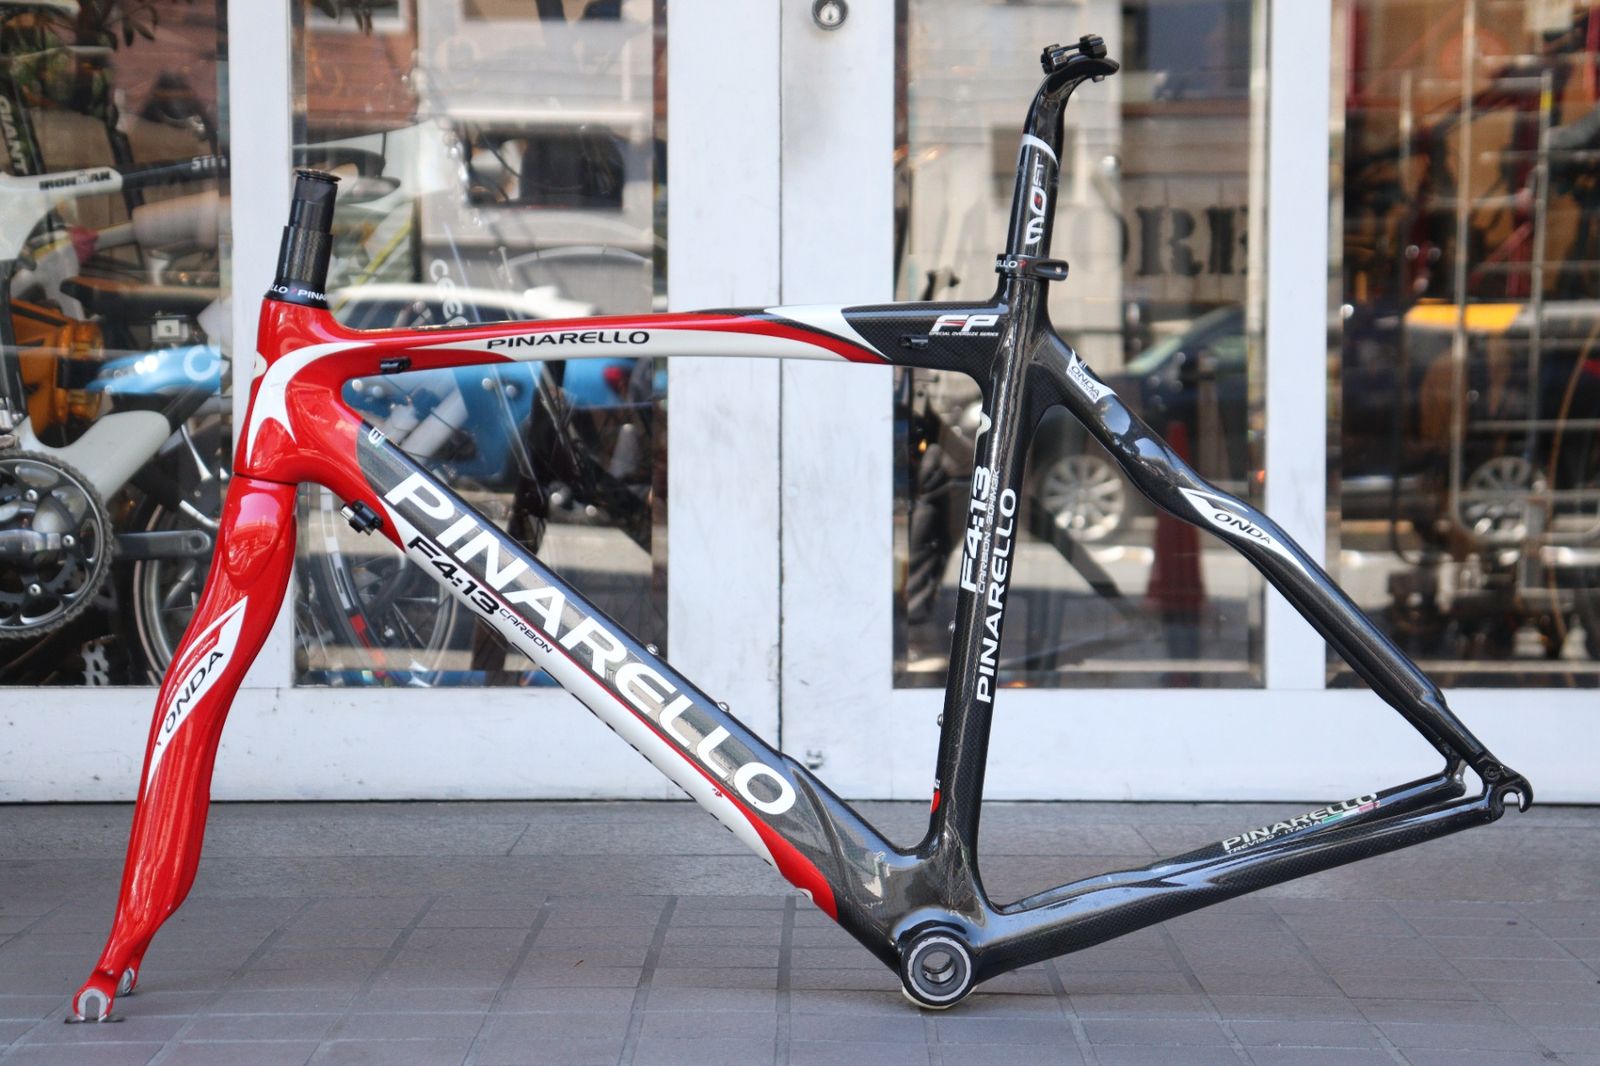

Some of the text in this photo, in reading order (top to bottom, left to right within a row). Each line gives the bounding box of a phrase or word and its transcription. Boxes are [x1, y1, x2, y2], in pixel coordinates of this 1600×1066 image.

[487, 331, 650, 349] PINARELLO
[930, 314, 1000, 332] FP
[1071, 365, 1100, 397] ONDA
[961, 465, 991, 593] F4:13
[1214, 512, 1272, 545] ONDA
[977, 531, 992, 594] CARBON
[407, 536, 553, 654] F4:13 CARBON
[976, 488, 1017, 703] PINARELLO
[384, 472, 797, 815] PINARELLO
[165, 651, 224, 734] ONDA
[1222, 793, 1377, 850] PINARELLO
